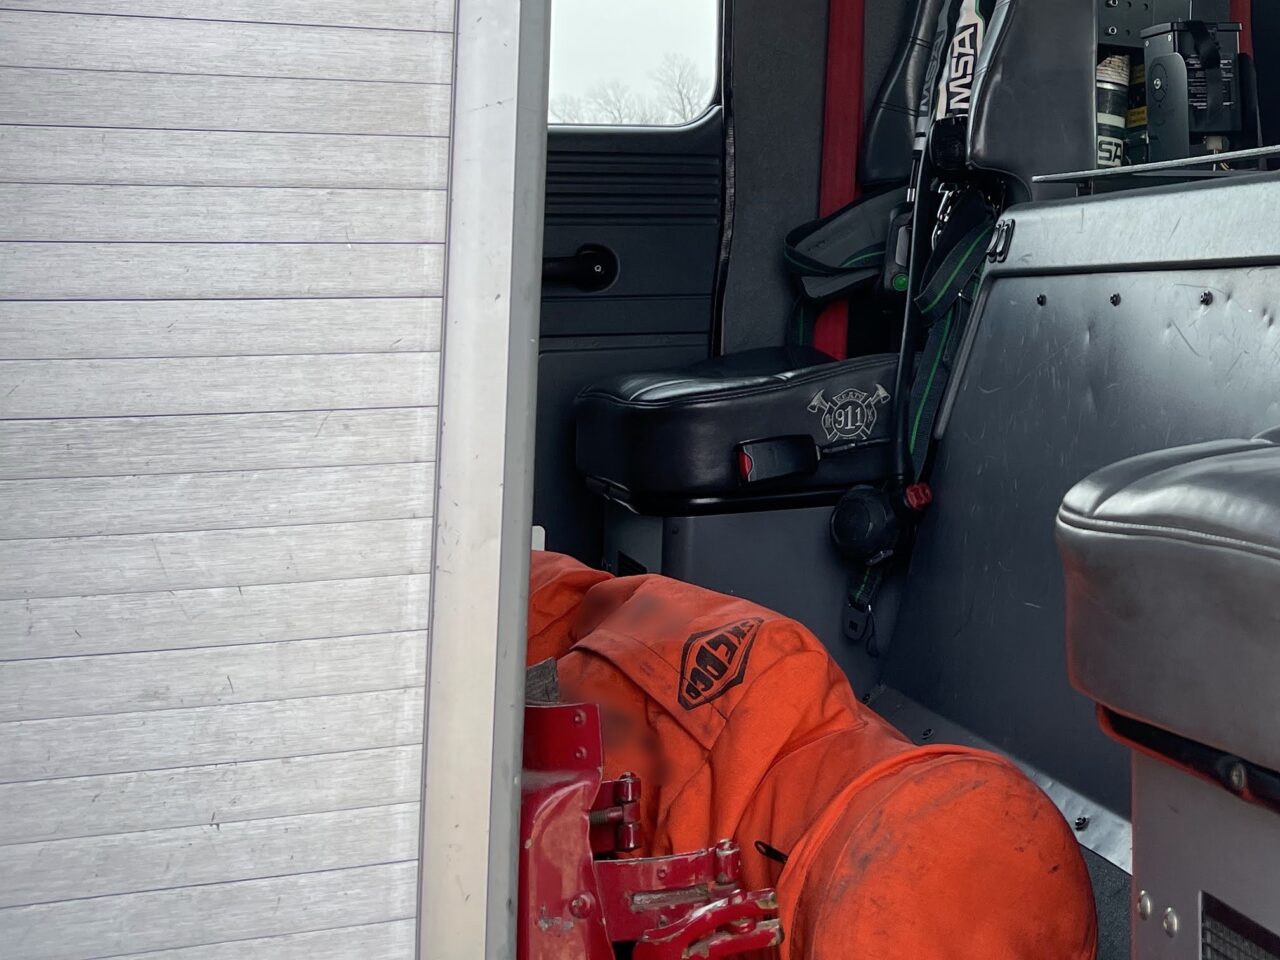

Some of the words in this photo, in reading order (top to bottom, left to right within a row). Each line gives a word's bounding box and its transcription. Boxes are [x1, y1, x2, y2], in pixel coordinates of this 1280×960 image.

[949, 26, 975, 110] MSA
[834, 405, 864, 429] 911
[686, 621, 755, 700] SKEDCO
